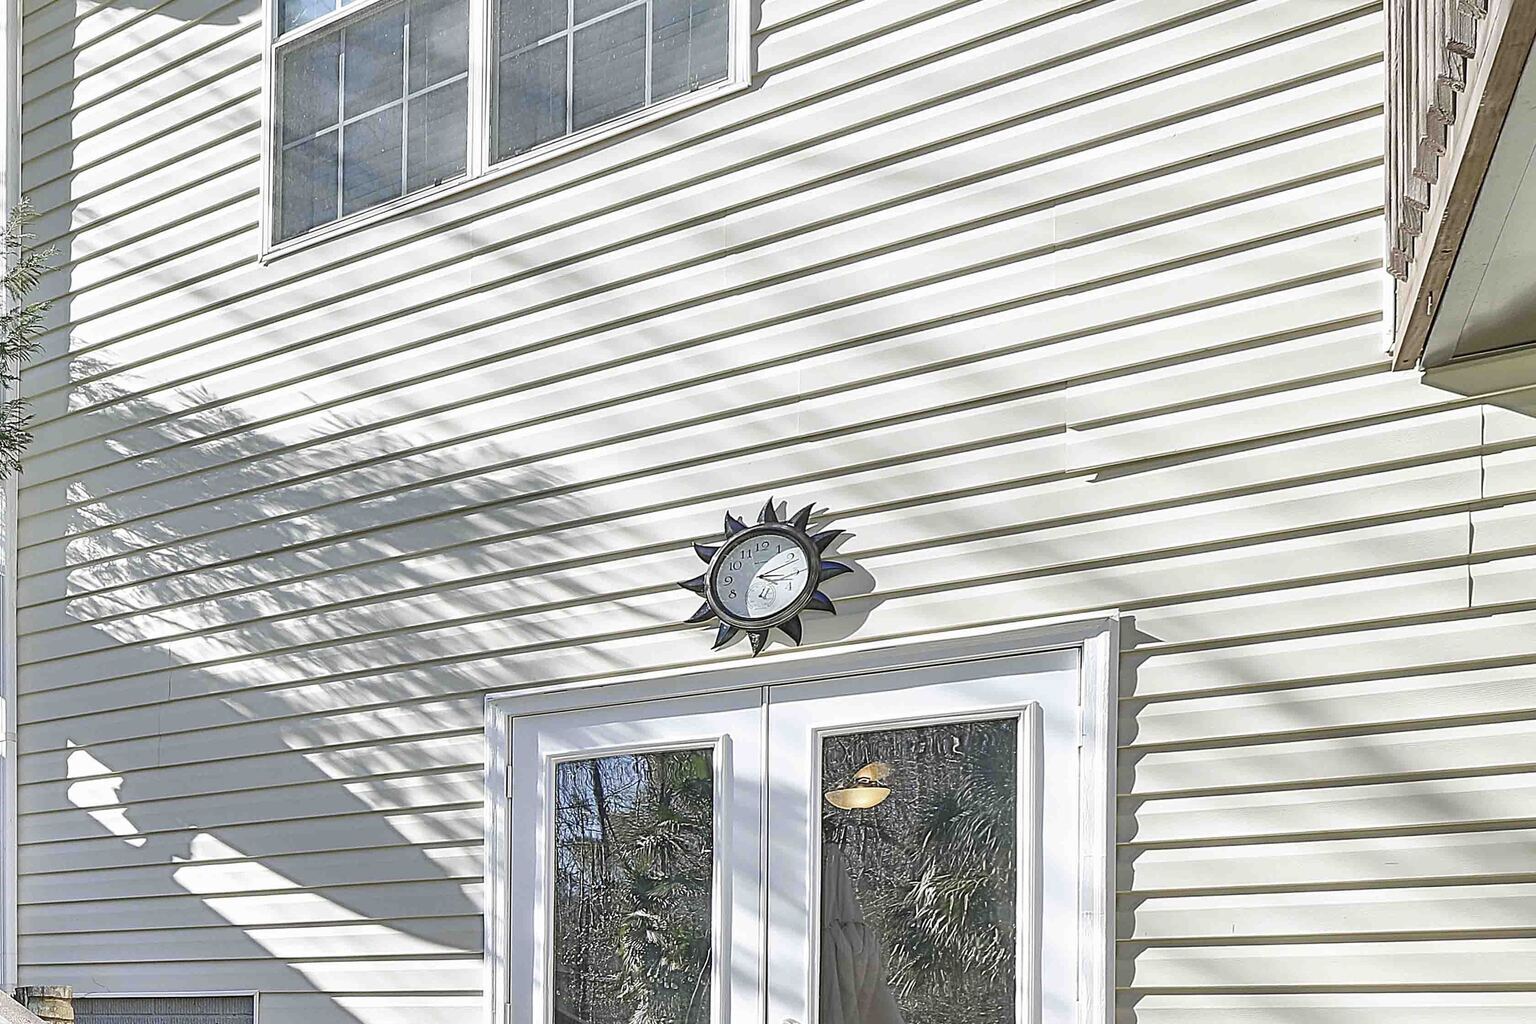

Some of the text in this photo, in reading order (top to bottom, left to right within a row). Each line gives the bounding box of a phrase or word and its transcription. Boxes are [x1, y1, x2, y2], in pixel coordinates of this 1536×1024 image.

[729, 560, 742, 570] 10
[723, 575, 733, 586] 9
[728, 589, 737, 599] 8
